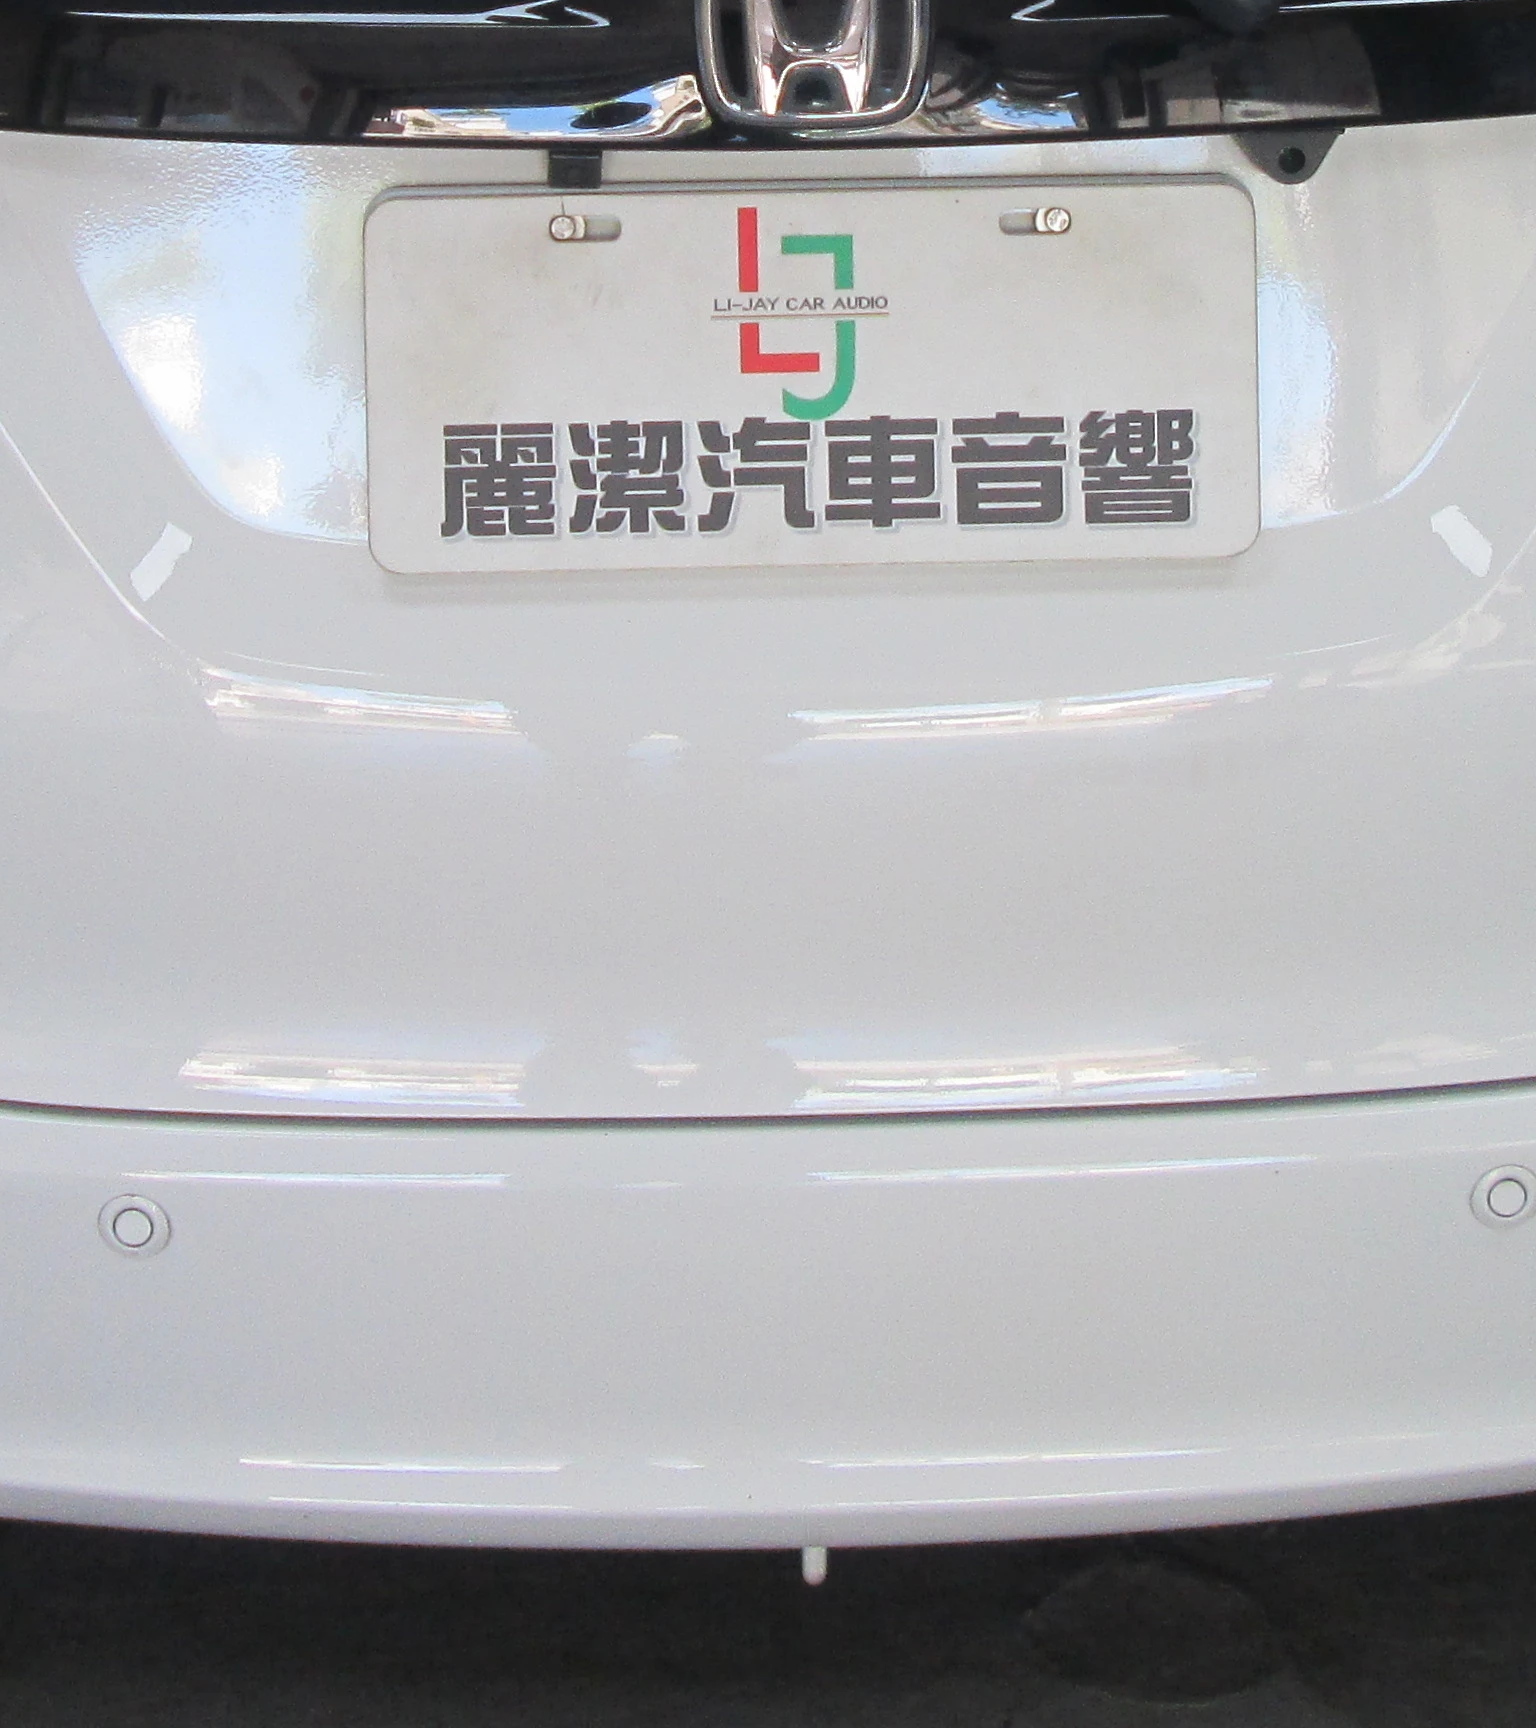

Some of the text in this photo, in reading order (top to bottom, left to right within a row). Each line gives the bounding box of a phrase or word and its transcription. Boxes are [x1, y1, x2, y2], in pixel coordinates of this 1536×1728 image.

[713, 295, 889, 312] LI-JAY CAR AUDIO
[440, 408, 1197, 539] 麗潔汽車音響
